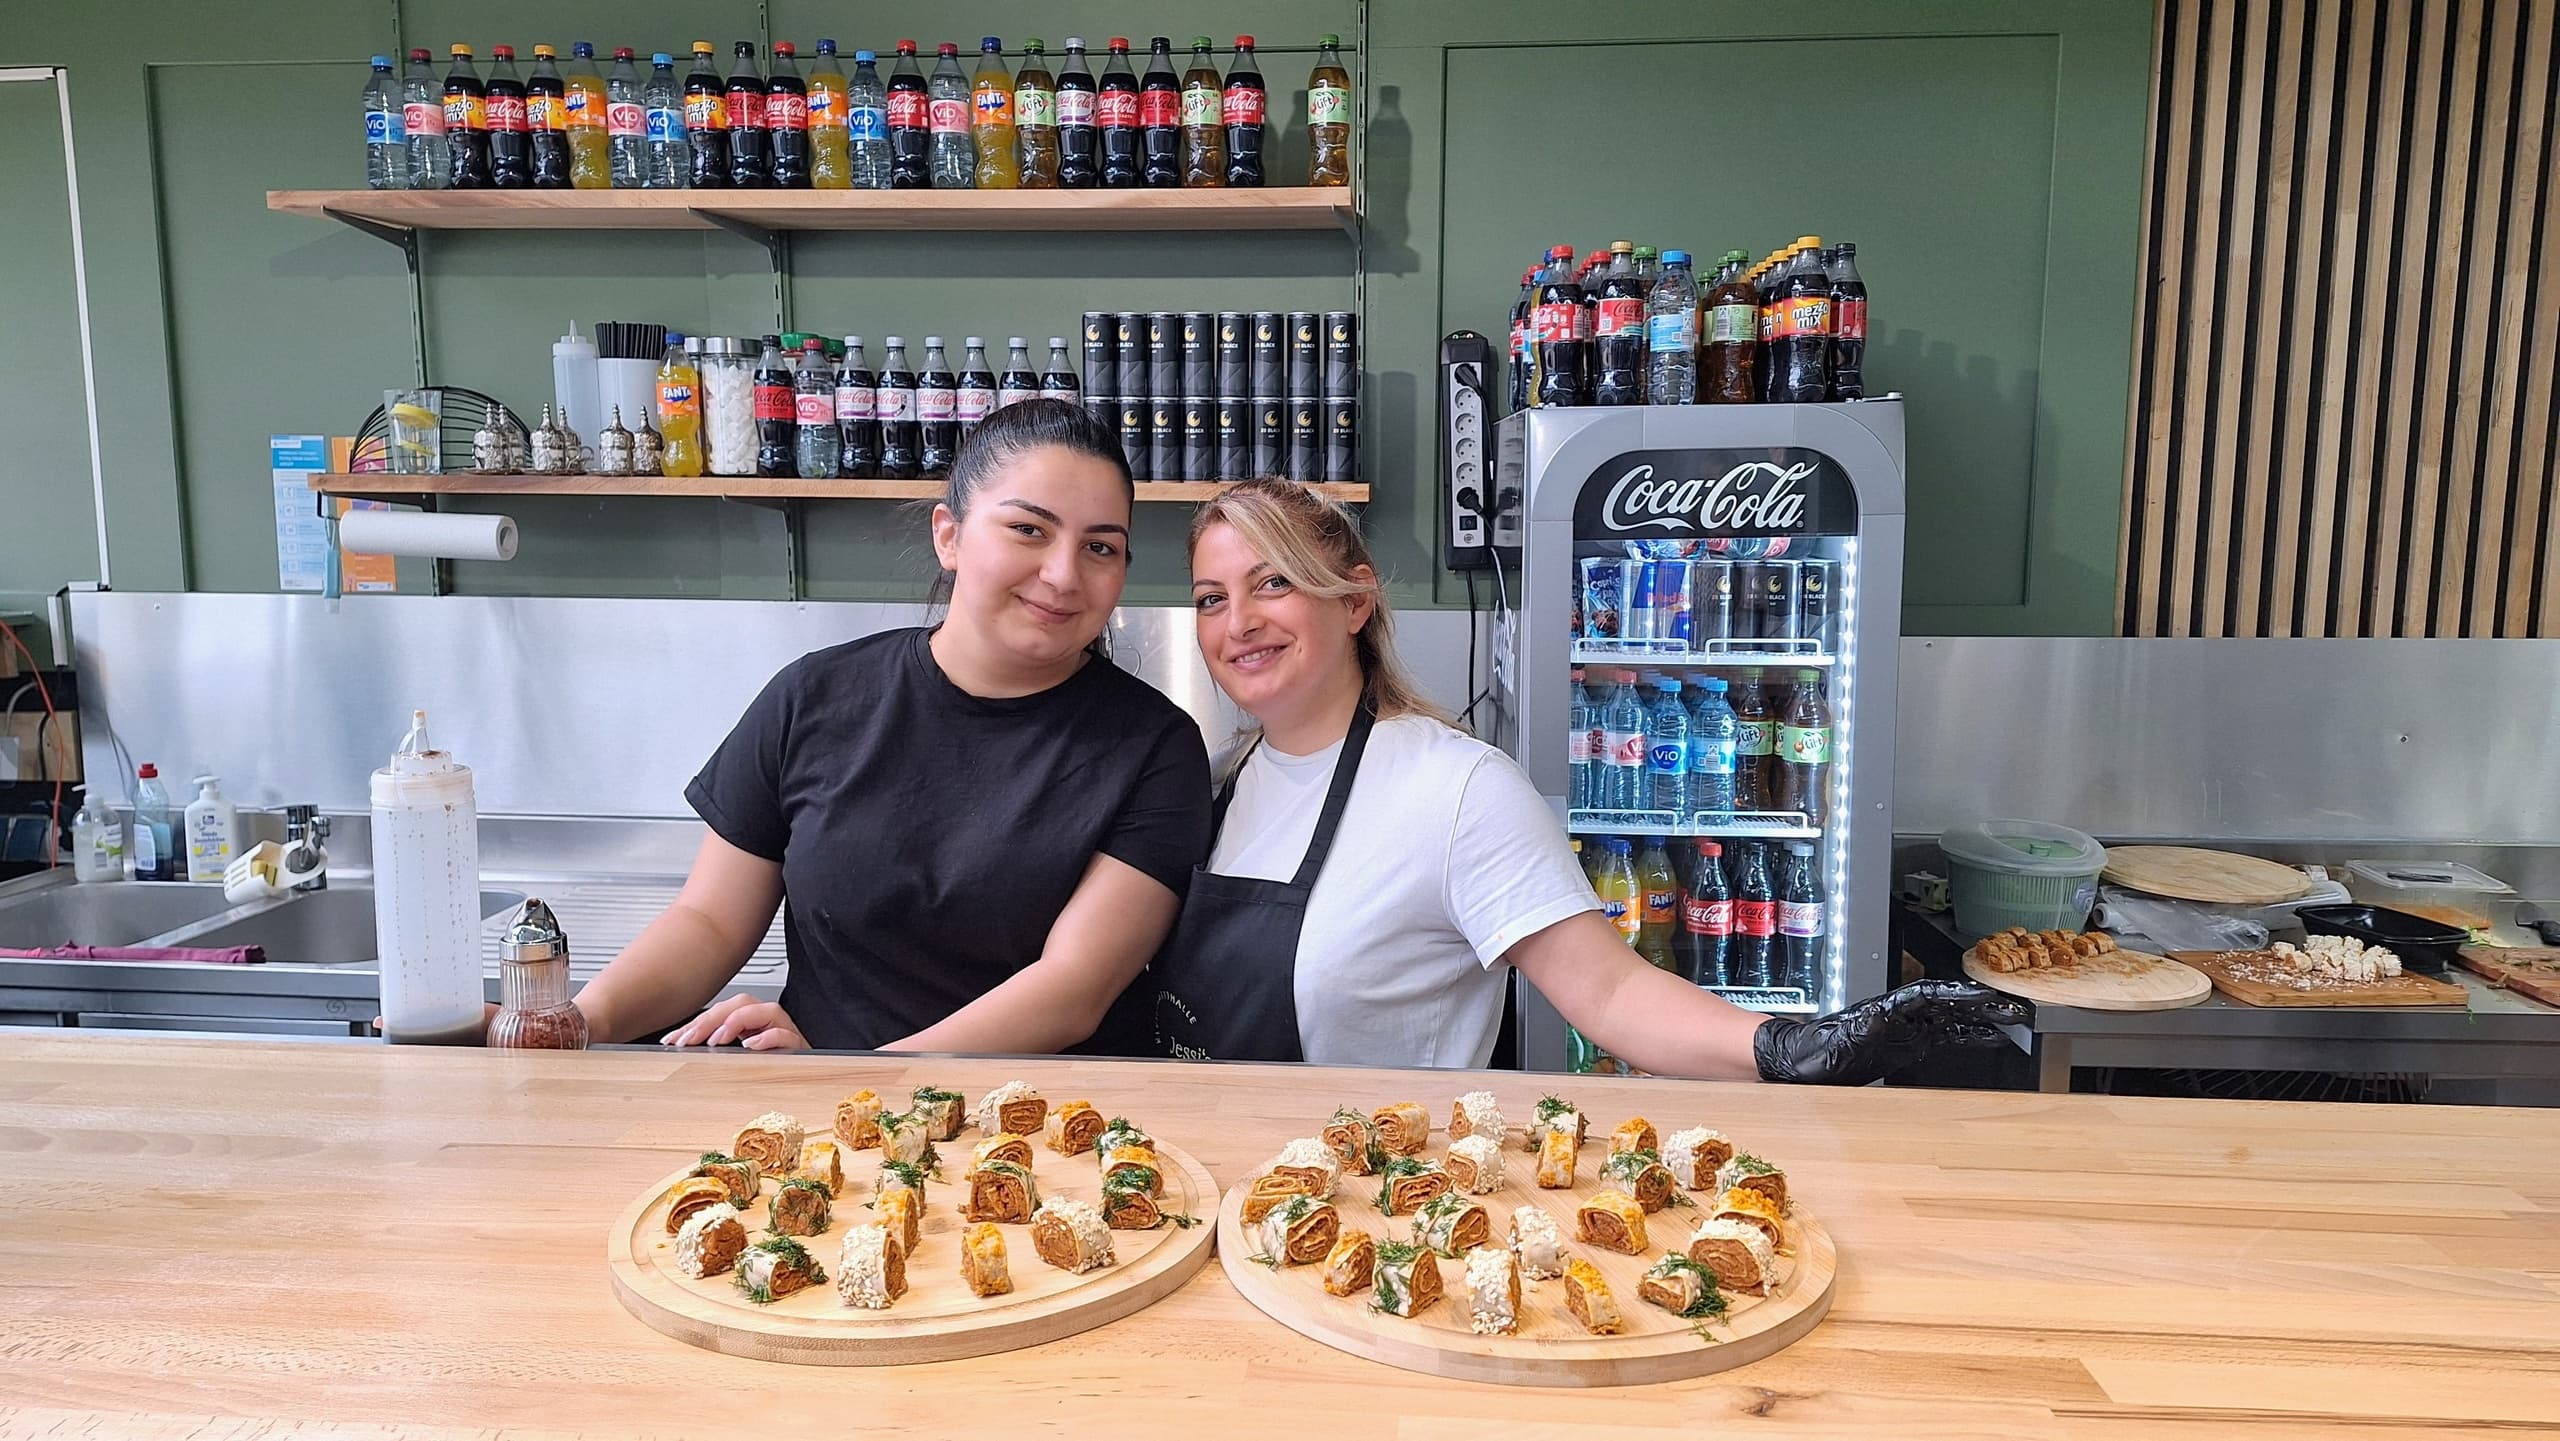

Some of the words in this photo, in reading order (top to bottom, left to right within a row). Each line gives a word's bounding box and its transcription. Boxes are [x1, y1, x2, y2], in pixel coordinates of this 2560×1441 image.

[976, 91, 1006, 107] FANTA
[1791, 301, 1829, 319] mezzo
[1796, 311, 1823, 329] mix
[798, 401, 818, 412] ViO
[1602, 461, 1820, 531] Coca-Cola
[1654, 750, 1679, 761] ViO
